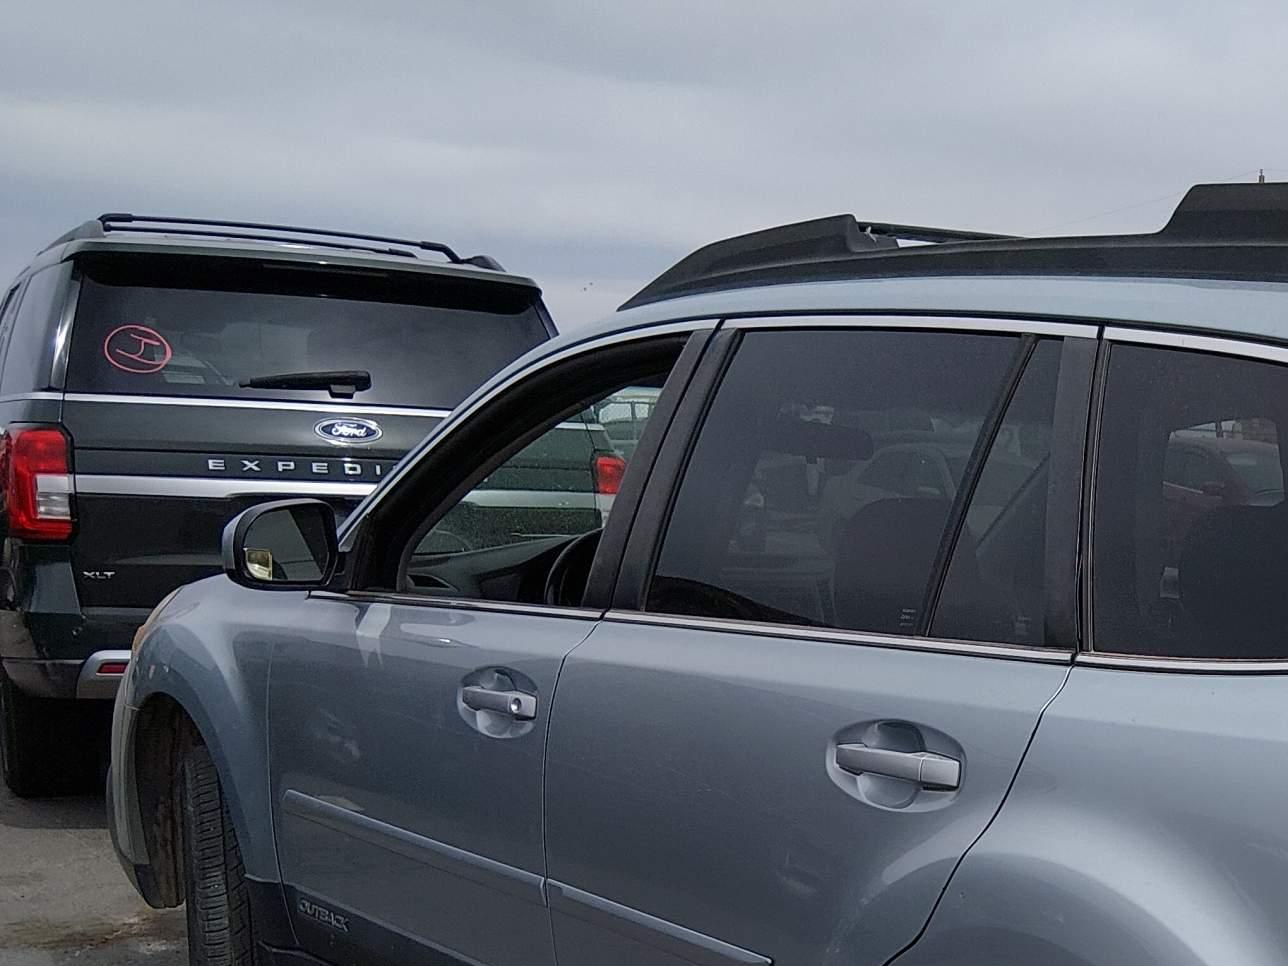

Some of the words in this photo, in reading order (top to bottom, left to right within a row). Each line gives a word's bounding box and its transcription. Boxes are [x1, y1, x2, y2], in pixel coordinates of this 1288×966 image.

[331, 422, 367, 437] Ford
[207, 458, 398, 476] EXPEDI
[82, 571, 116, 580] XLT
[299, 899, 350, 933] OUTBACK
